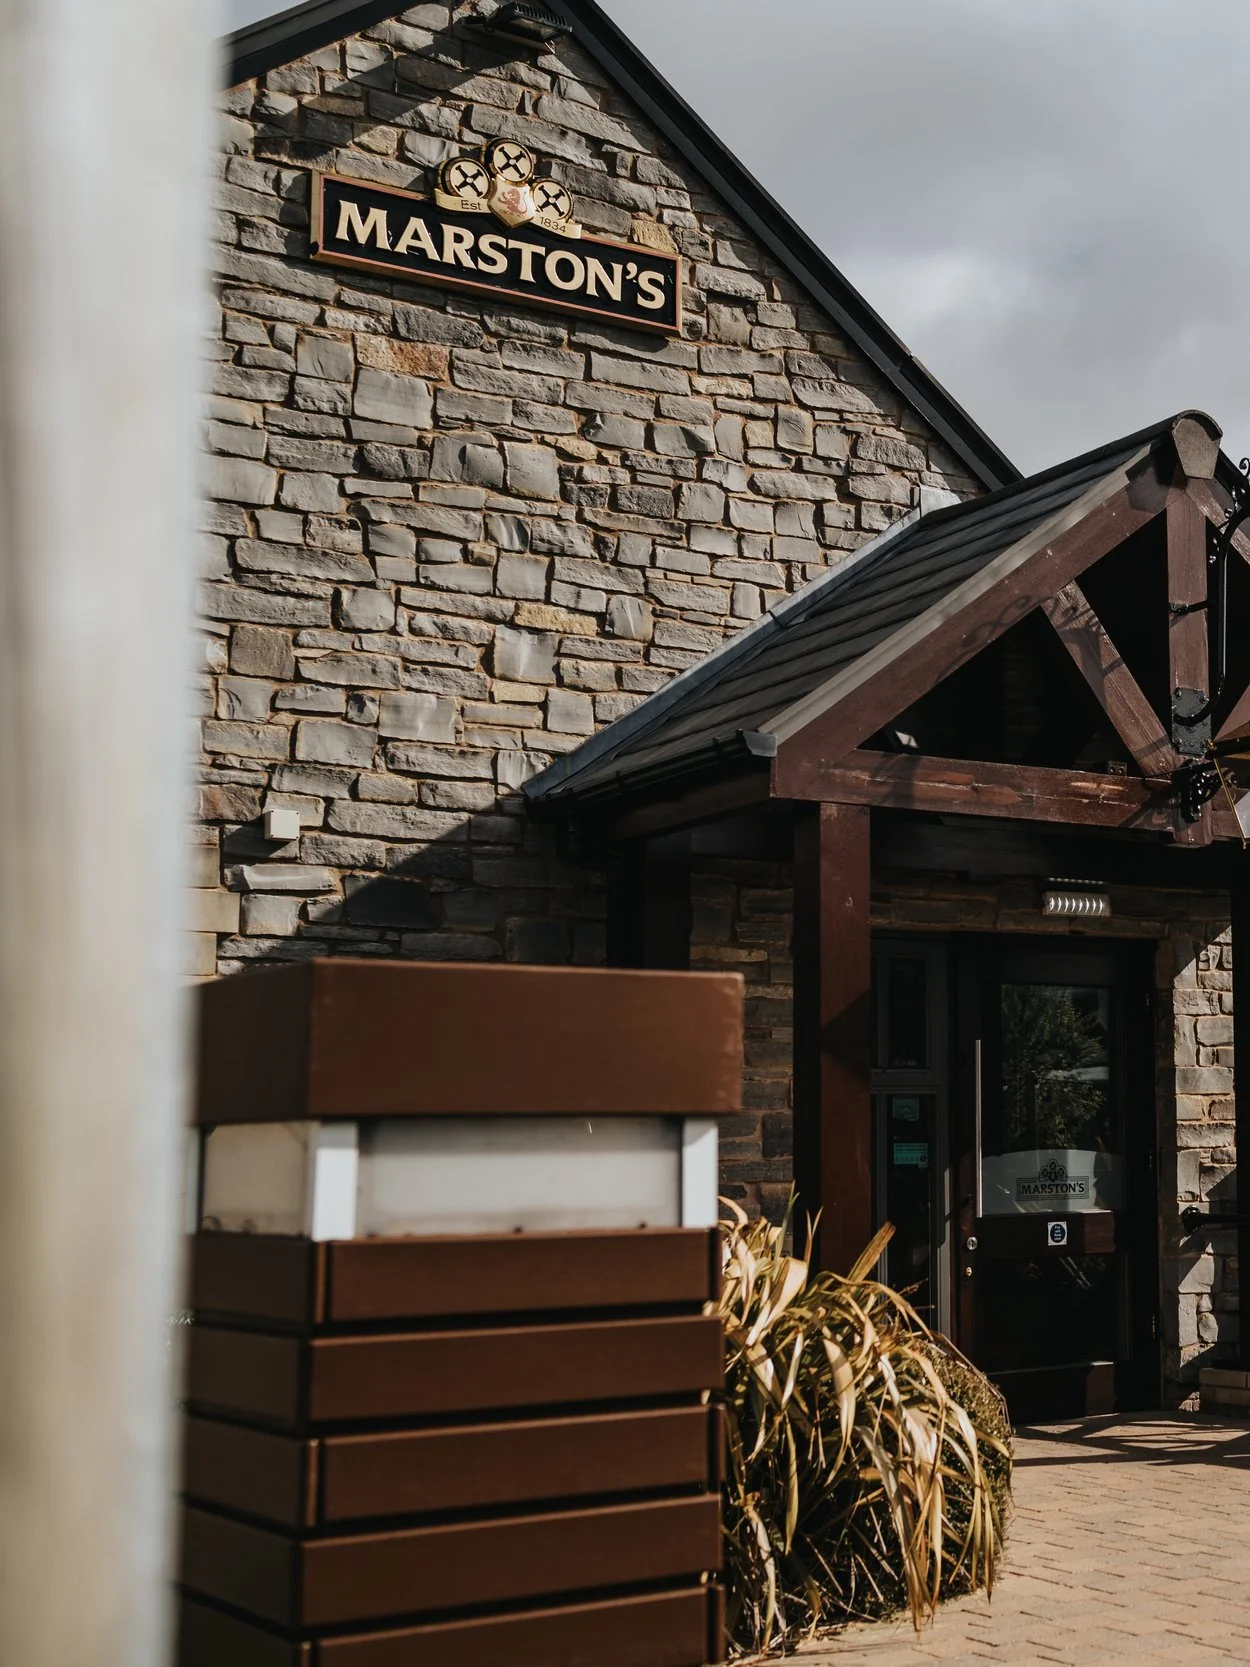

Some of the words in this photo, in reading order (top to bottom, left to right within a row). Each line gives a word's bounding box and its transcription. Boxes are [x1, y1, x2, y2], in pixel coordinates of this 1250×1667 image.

[461, 199, 482, 211] Est
[539, 216, 567, 234] 1834
[335, 199, 666, 310] MARSTON'S
[1022, 1183, 1084, 1194] MARSTON'S
